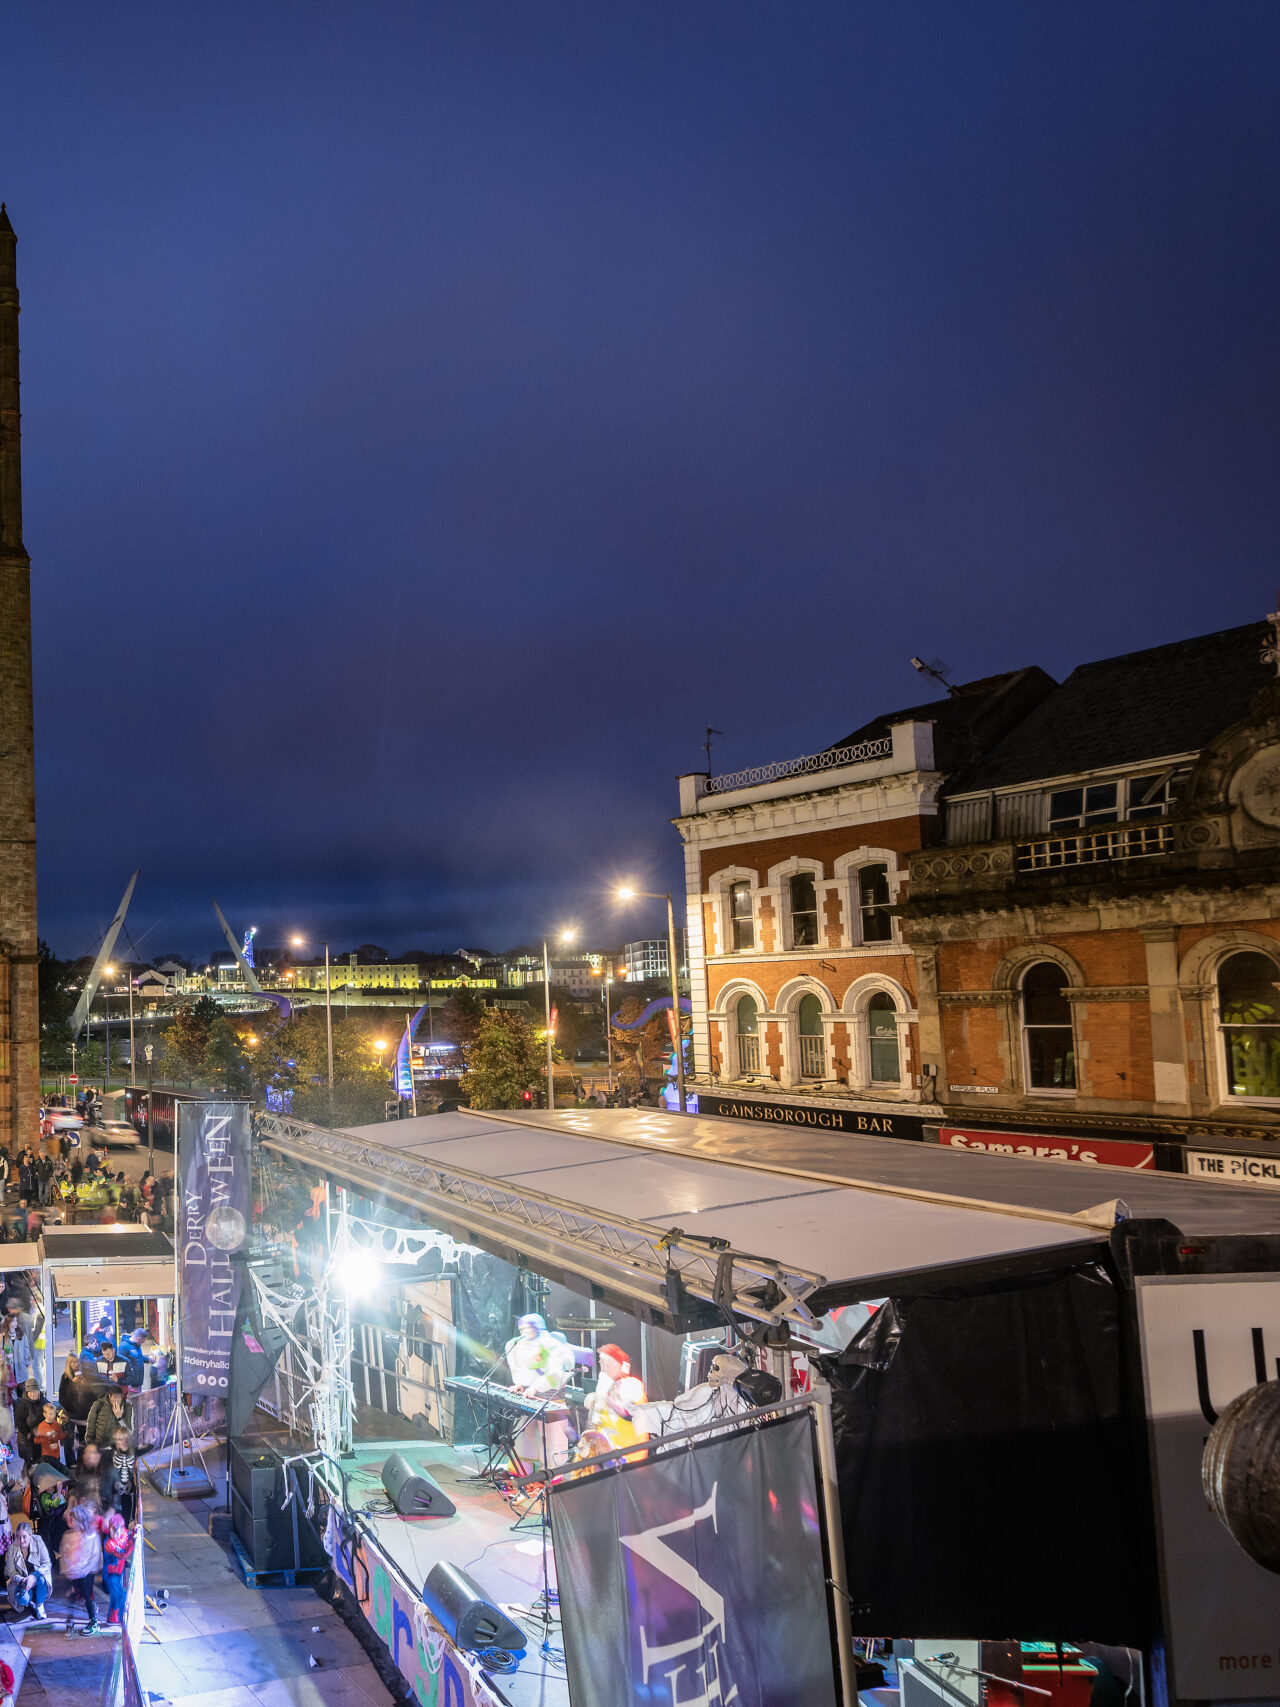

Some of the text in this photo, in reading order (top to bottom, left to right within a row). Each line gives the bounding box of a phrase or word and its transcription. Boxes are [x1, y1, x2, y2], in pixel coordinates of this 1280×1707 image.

[718, 1103, 894, 1133] GAINSBOROUGH BAR
[1198, 1157, 1224, 1173] THE
[185, 1189, 208, 1267] DERRY
[1219, 1654, 1273, 1671] more
